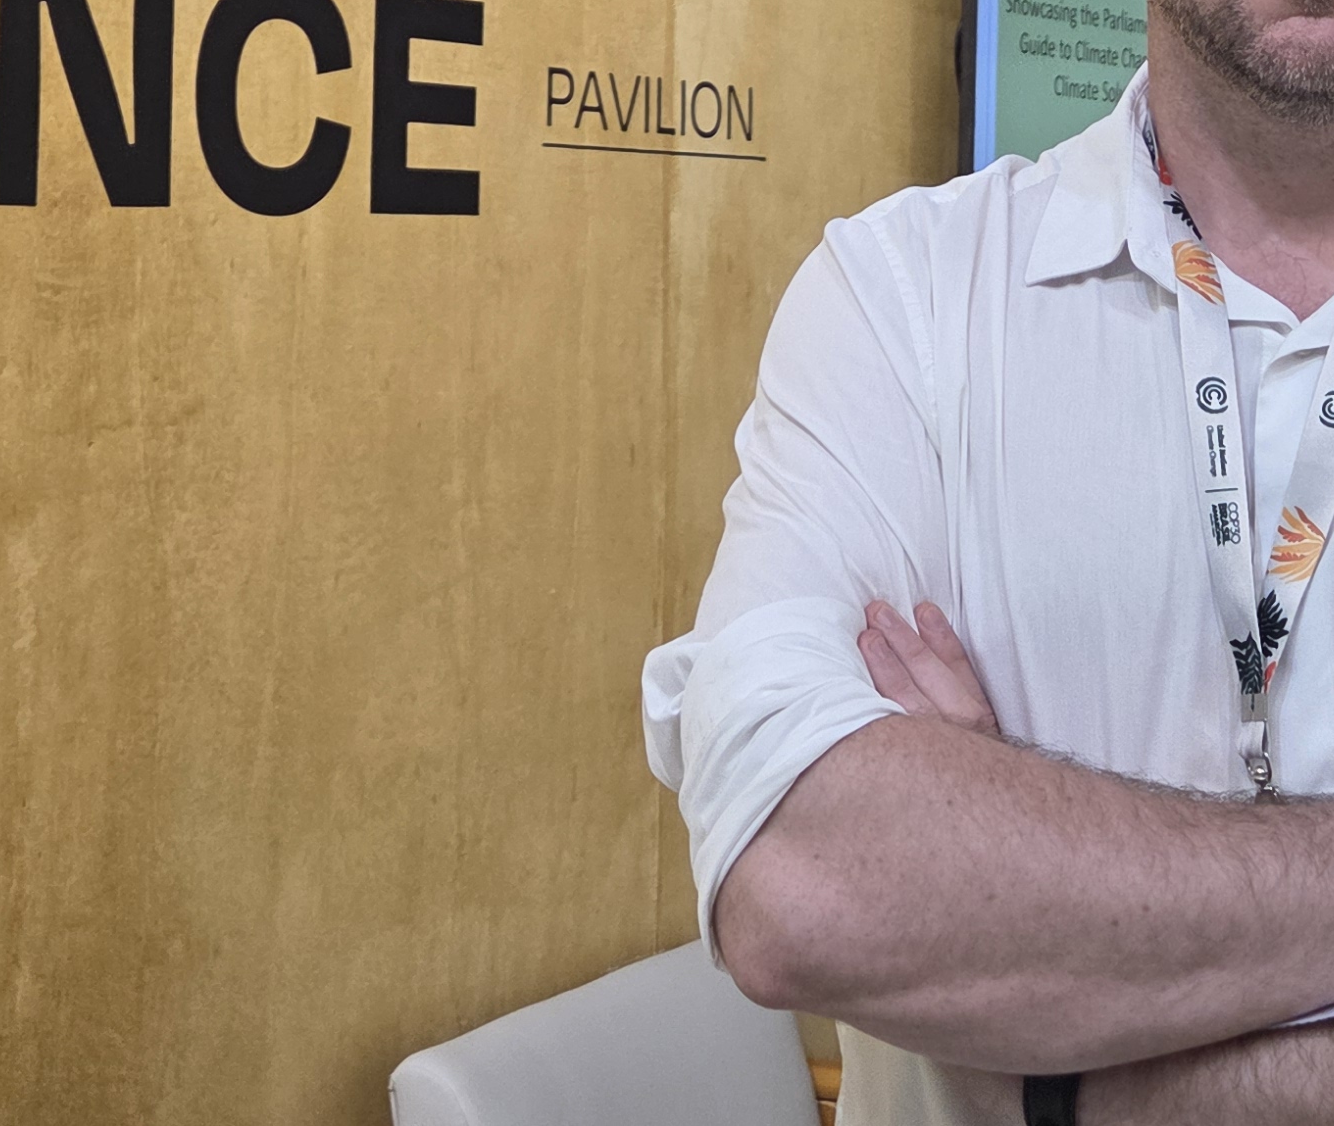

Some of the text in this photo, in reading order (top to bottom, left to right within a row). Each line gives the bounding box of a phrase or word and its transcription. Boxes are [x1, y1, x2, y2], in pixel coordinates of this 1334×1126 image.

[1080, 4, 1099, 27] the
[1103, 8, 1147, 34] Parliam
[1019, 32, 1147, 68] Guide to Climate Cha
[547, 67, 753, 141] PAVILION
[1053, 75, 1099, 100] Climate
